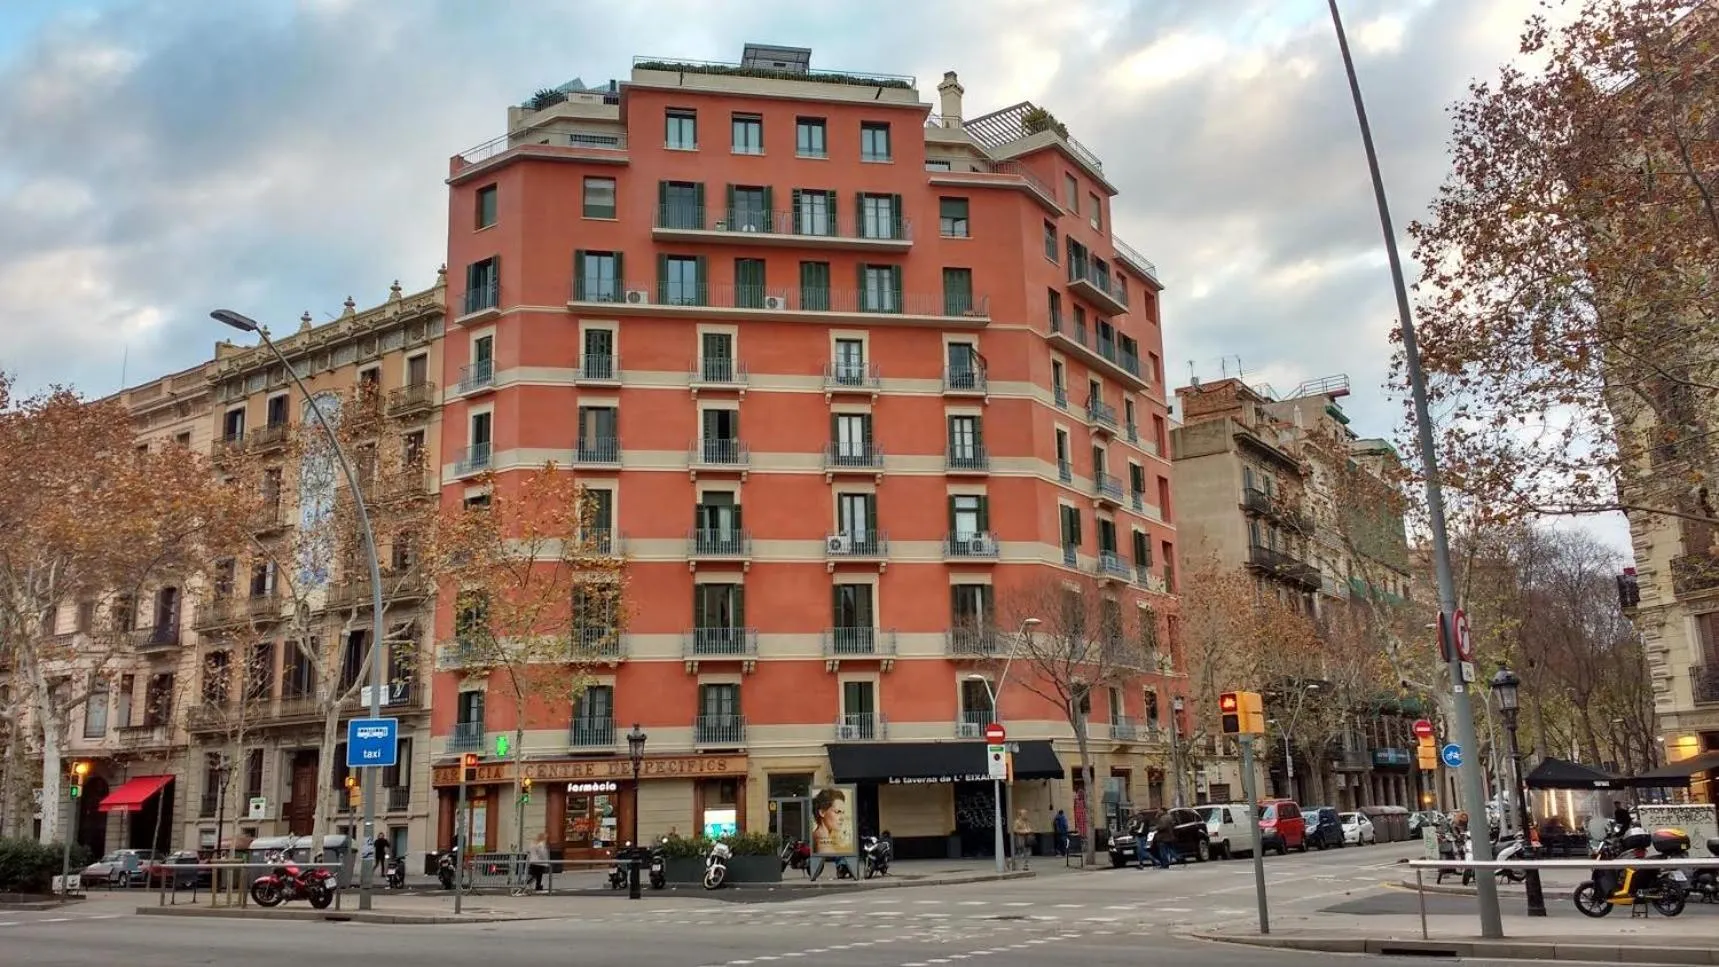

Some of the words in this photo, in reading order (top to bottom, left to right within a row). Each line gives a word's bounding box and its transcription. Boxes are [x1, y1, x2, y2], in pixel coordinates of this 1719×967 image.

[363, 748, 381, 759] taxi
[525, 763, 594, 778] CENTRE
[903, 776, 937, 784] taverna
